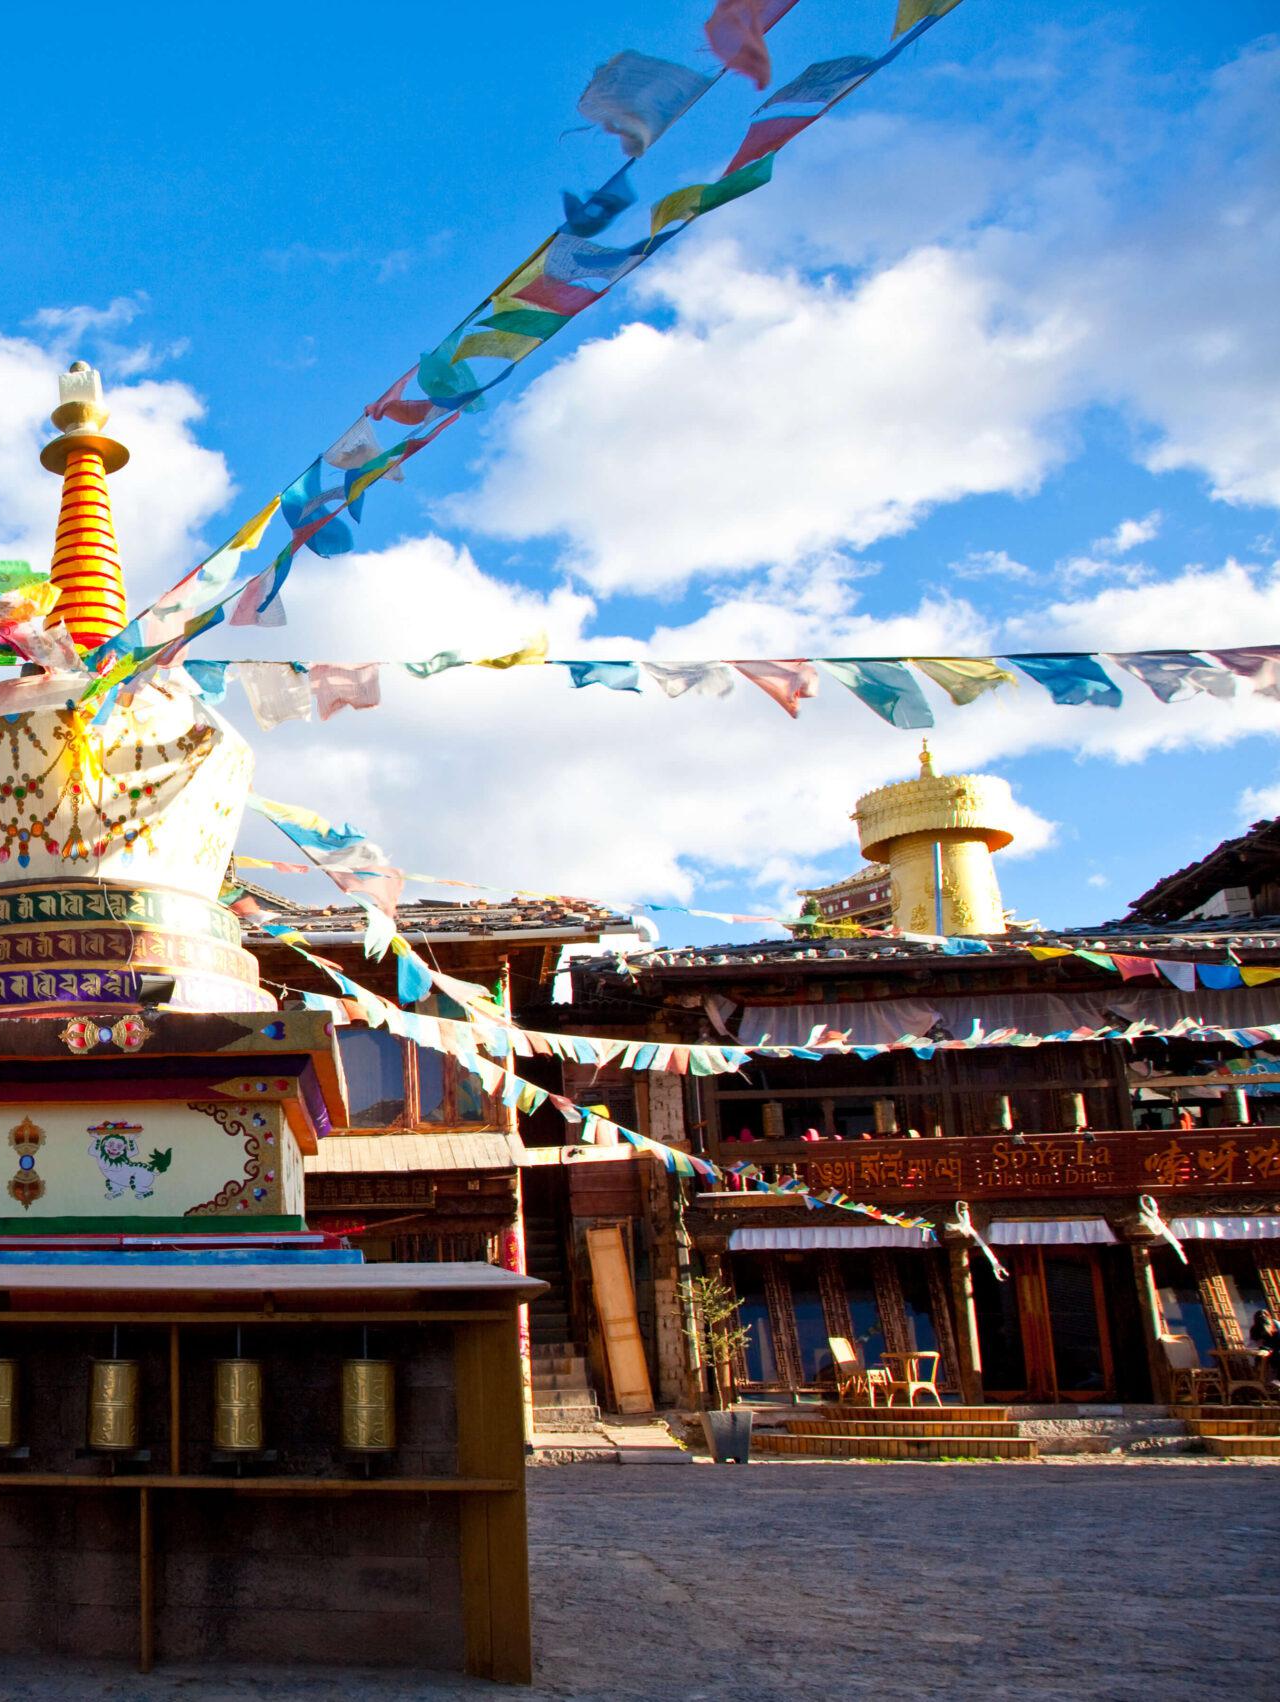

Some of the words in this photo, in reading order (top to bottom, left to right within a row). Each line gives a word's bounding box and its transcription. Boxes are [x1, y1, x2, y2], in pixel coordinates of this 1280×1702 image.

[1074, 1140, 1110, 1165] La
[983, 1171, 1051, 1187] Tibetan
[1065, 1168, 1115, 1184] Diner
